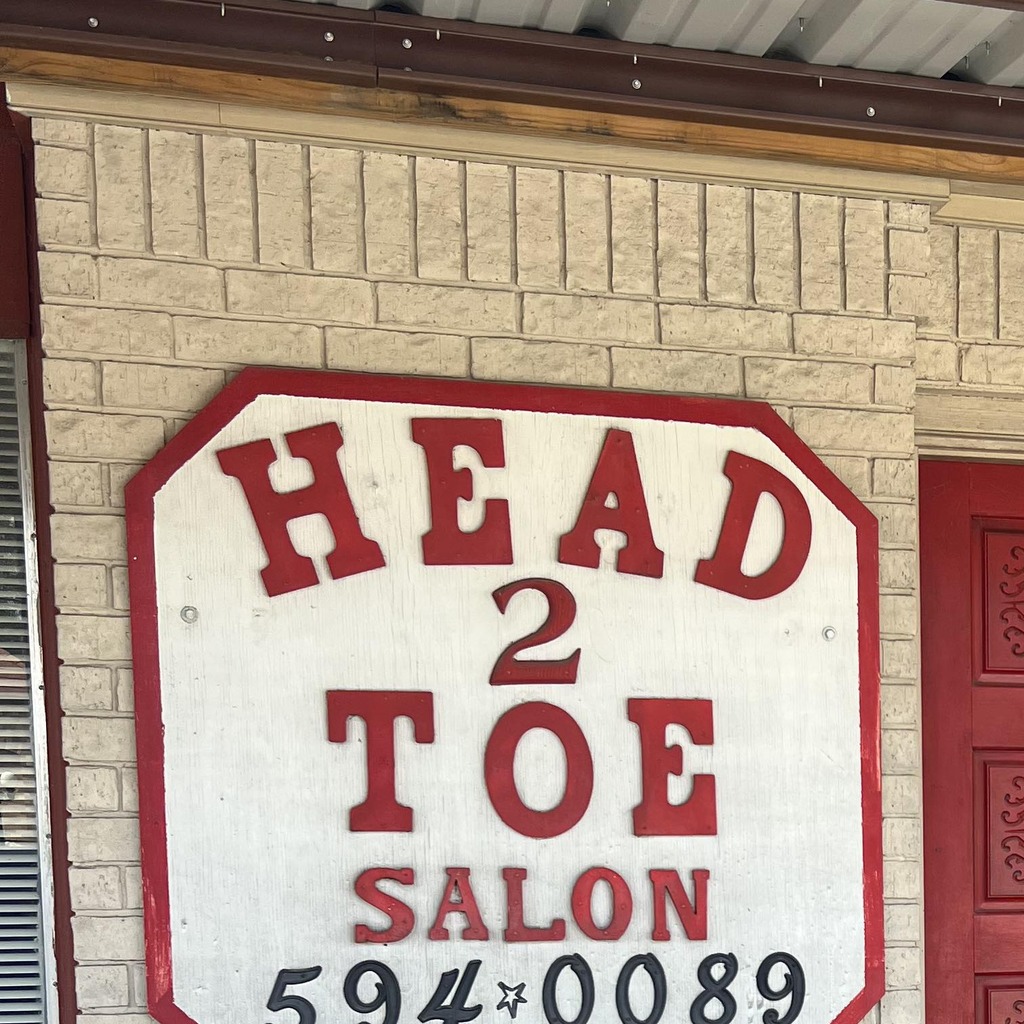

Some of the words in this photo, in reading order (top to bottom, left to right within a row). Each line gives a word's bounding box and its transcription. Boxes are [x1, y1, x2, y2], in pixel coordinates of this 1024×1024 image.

[217, 416, 813, 600] HEAD
[490, 577, 582, 687] 2
[325, 689, 718, 839] TOE
[354, 866, 710, 944] SALON
